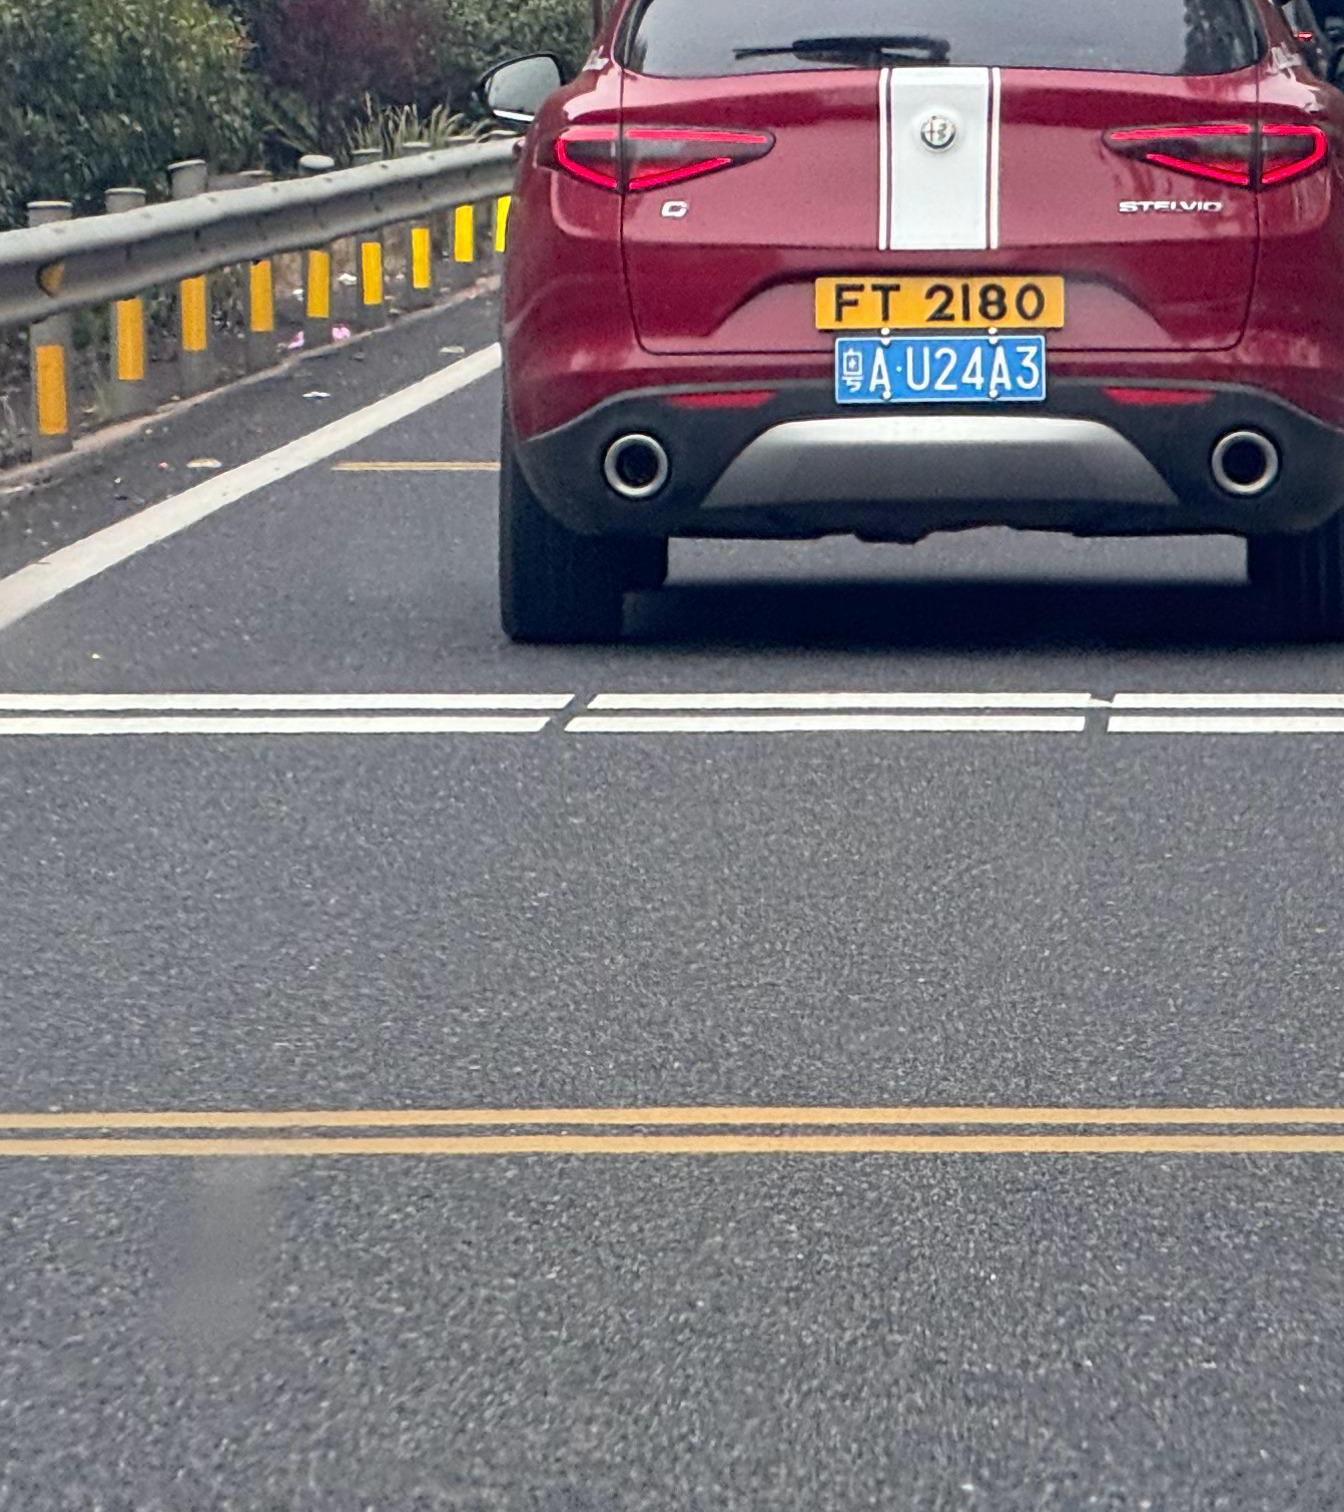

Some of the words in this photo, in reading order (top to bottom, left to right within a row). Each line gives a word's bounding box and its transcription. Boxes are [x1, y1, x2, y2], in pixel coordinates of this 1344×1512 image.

[1119, 200, 1223, 213] STELVIO
[834, 283, 901, 322] FT
[924, 282, 1046, 322] 2180
